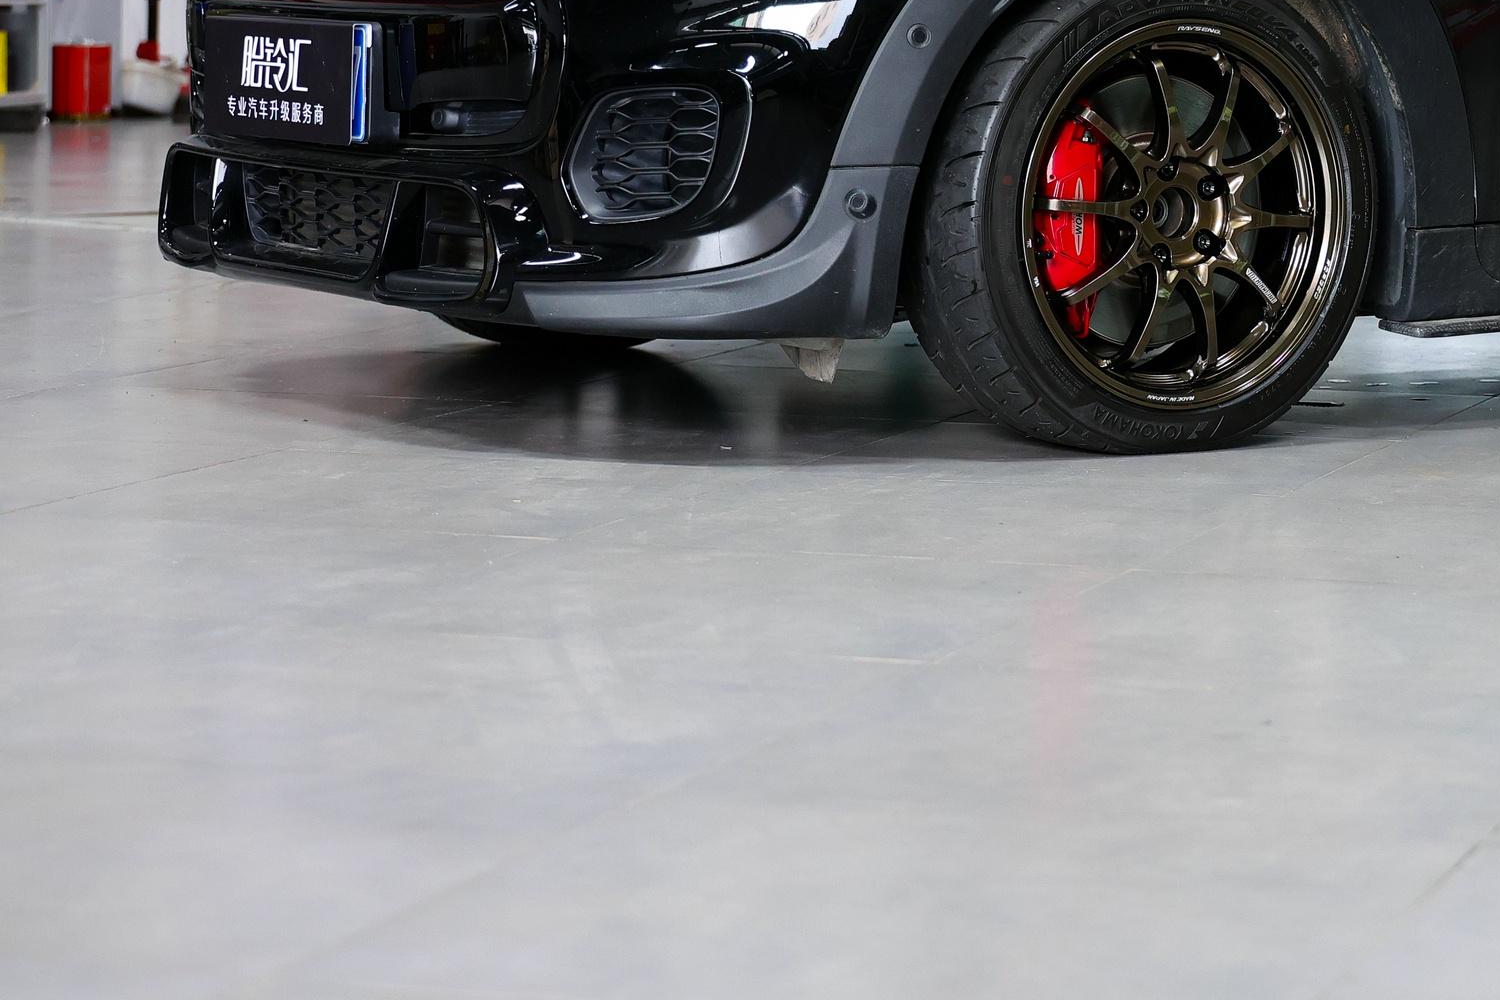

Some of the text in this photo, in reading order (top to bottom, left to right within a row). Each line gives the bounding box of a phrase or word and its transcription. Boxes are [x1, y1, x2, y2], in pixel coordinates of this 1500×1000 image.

[227, 95, 325, 126] 专业汽车升级服务商
